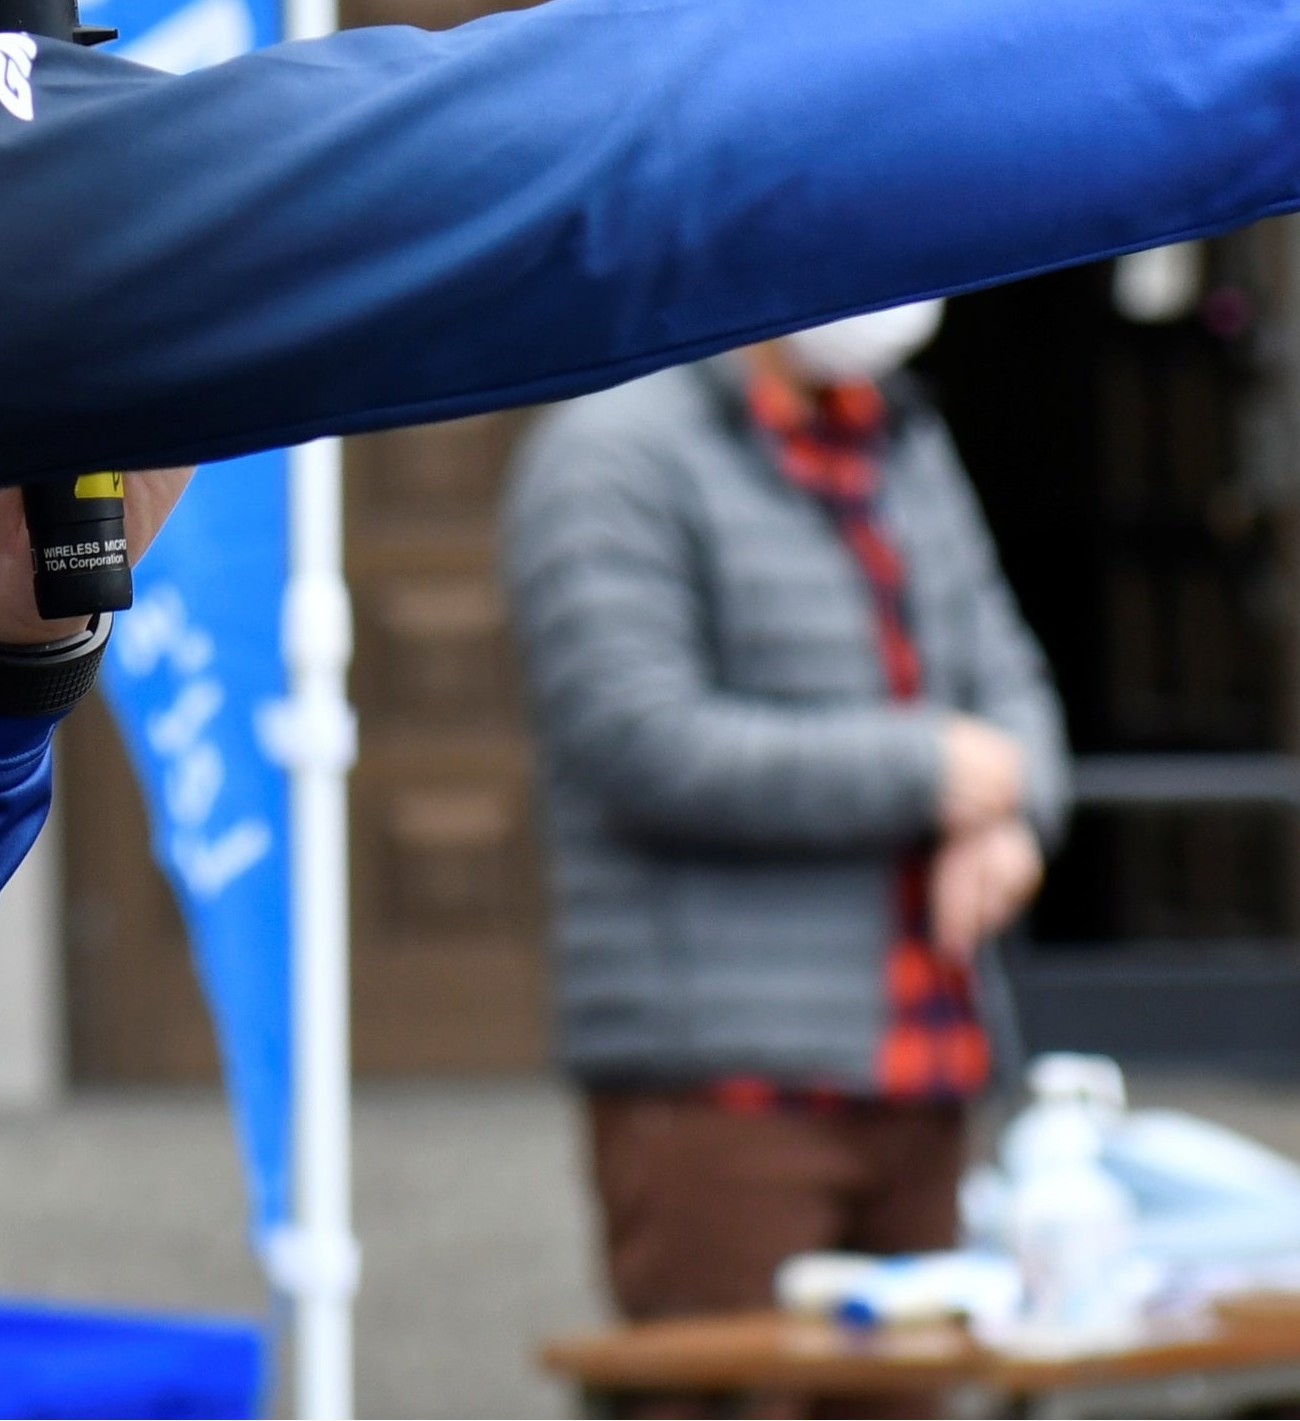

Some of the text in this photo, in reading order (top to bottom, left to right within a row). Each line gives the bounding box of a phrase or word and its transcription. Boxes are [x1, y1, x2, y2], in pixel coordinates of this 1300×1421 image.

[43, 542, 101, 559] WIRELESS
[45, 553, 124, 572] TOA Corporation
